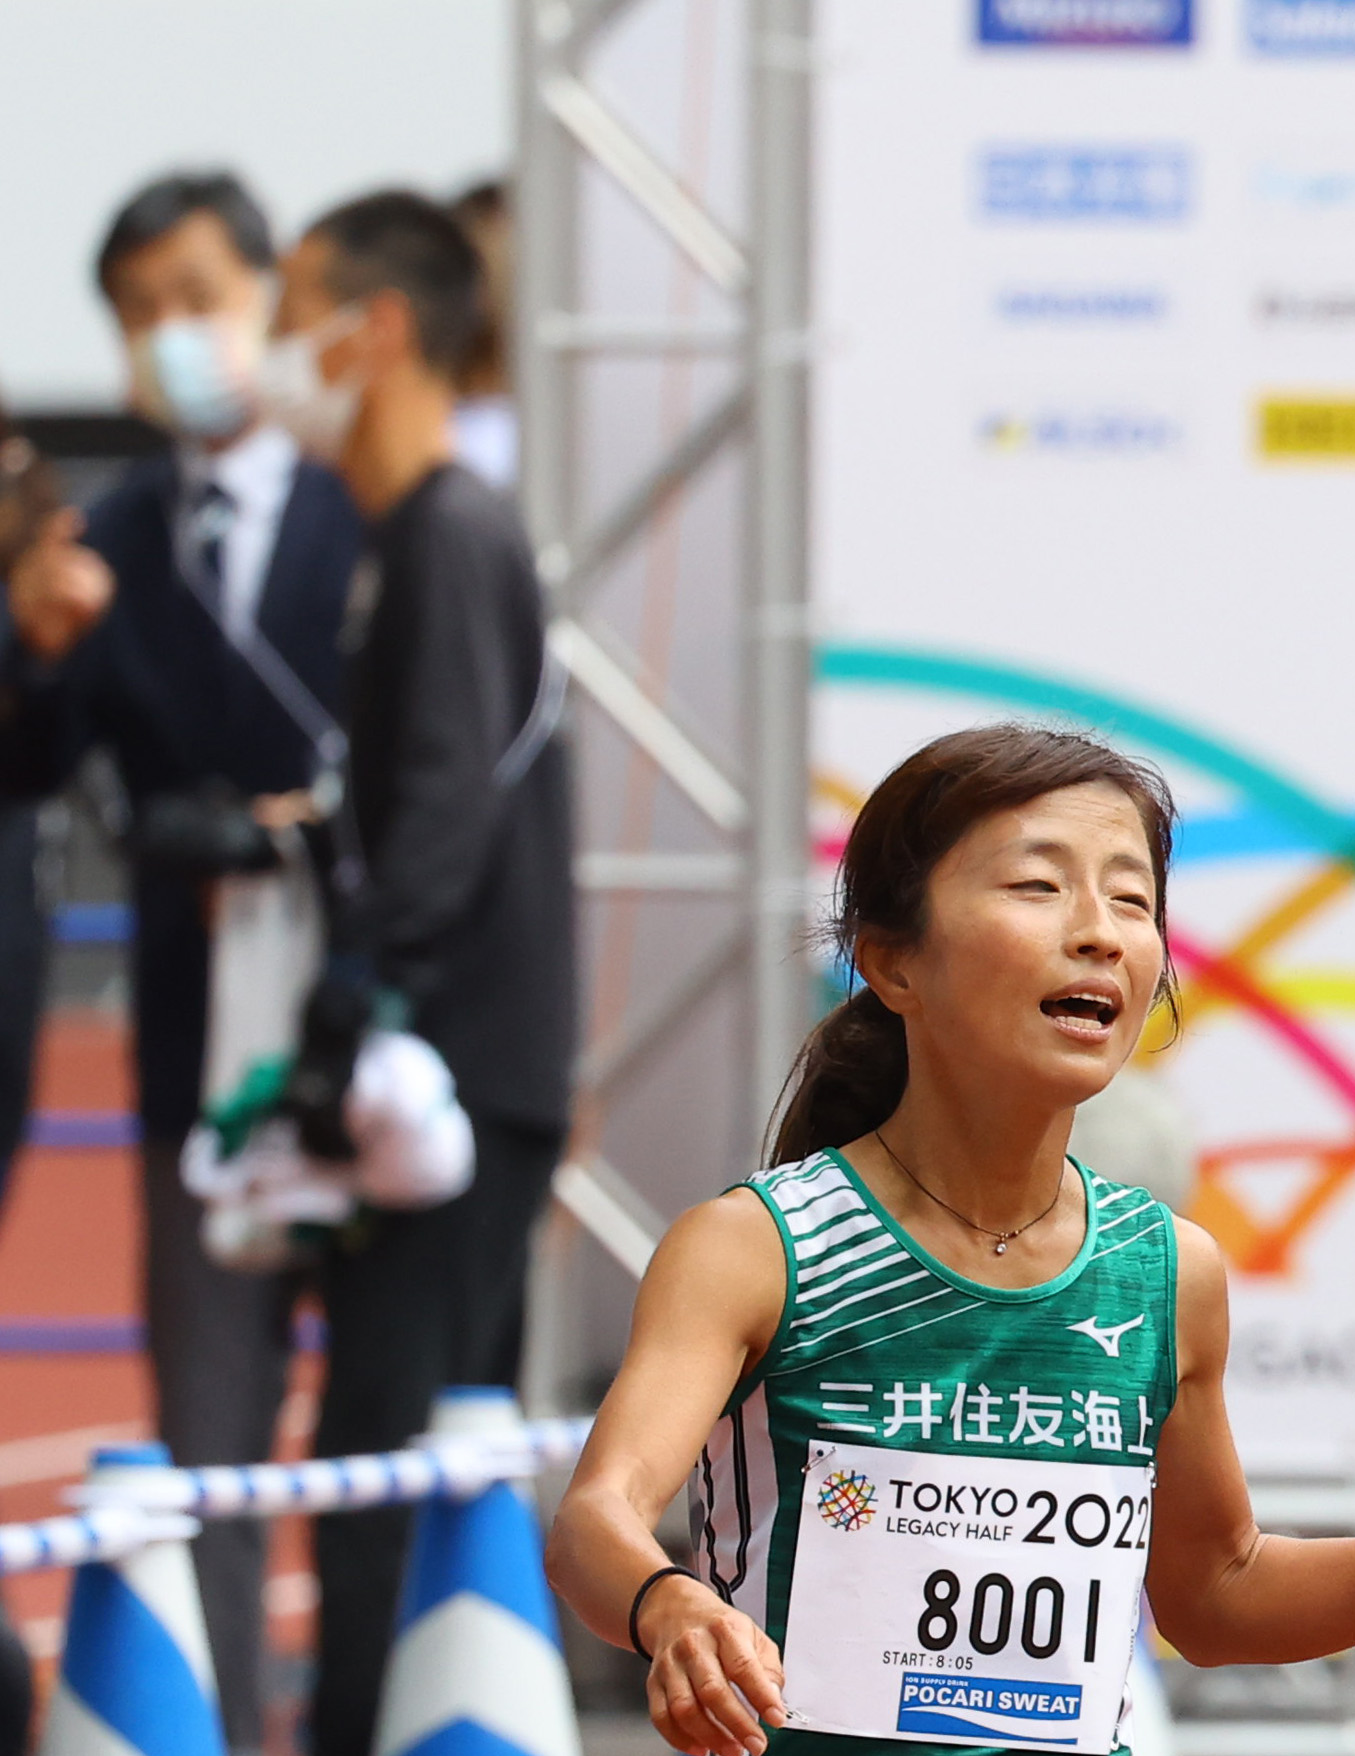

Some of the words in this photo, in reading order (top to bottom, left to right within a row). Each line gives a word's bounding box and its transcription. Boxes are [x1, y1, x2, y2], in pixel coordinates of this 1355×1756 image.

[816, 1381, 1155, 1457] 三井住友海上
[886, 1517, 961, 1539] LEGACY
[965, 1523, 1014, 1542] HALF
[889, 1479, 1019, 1518] TOKYO
[1022, 1490, 1149, 1550] 2022
[917, 1569, 1101, 1663] 8001
[903, 1685, 993, 1708] POCARI
[998, 1691, 1080, 1714] SWEAT
[905, 1676, 919, 1684] ION
[921, 1678, 946, 1686] SUPPLY
